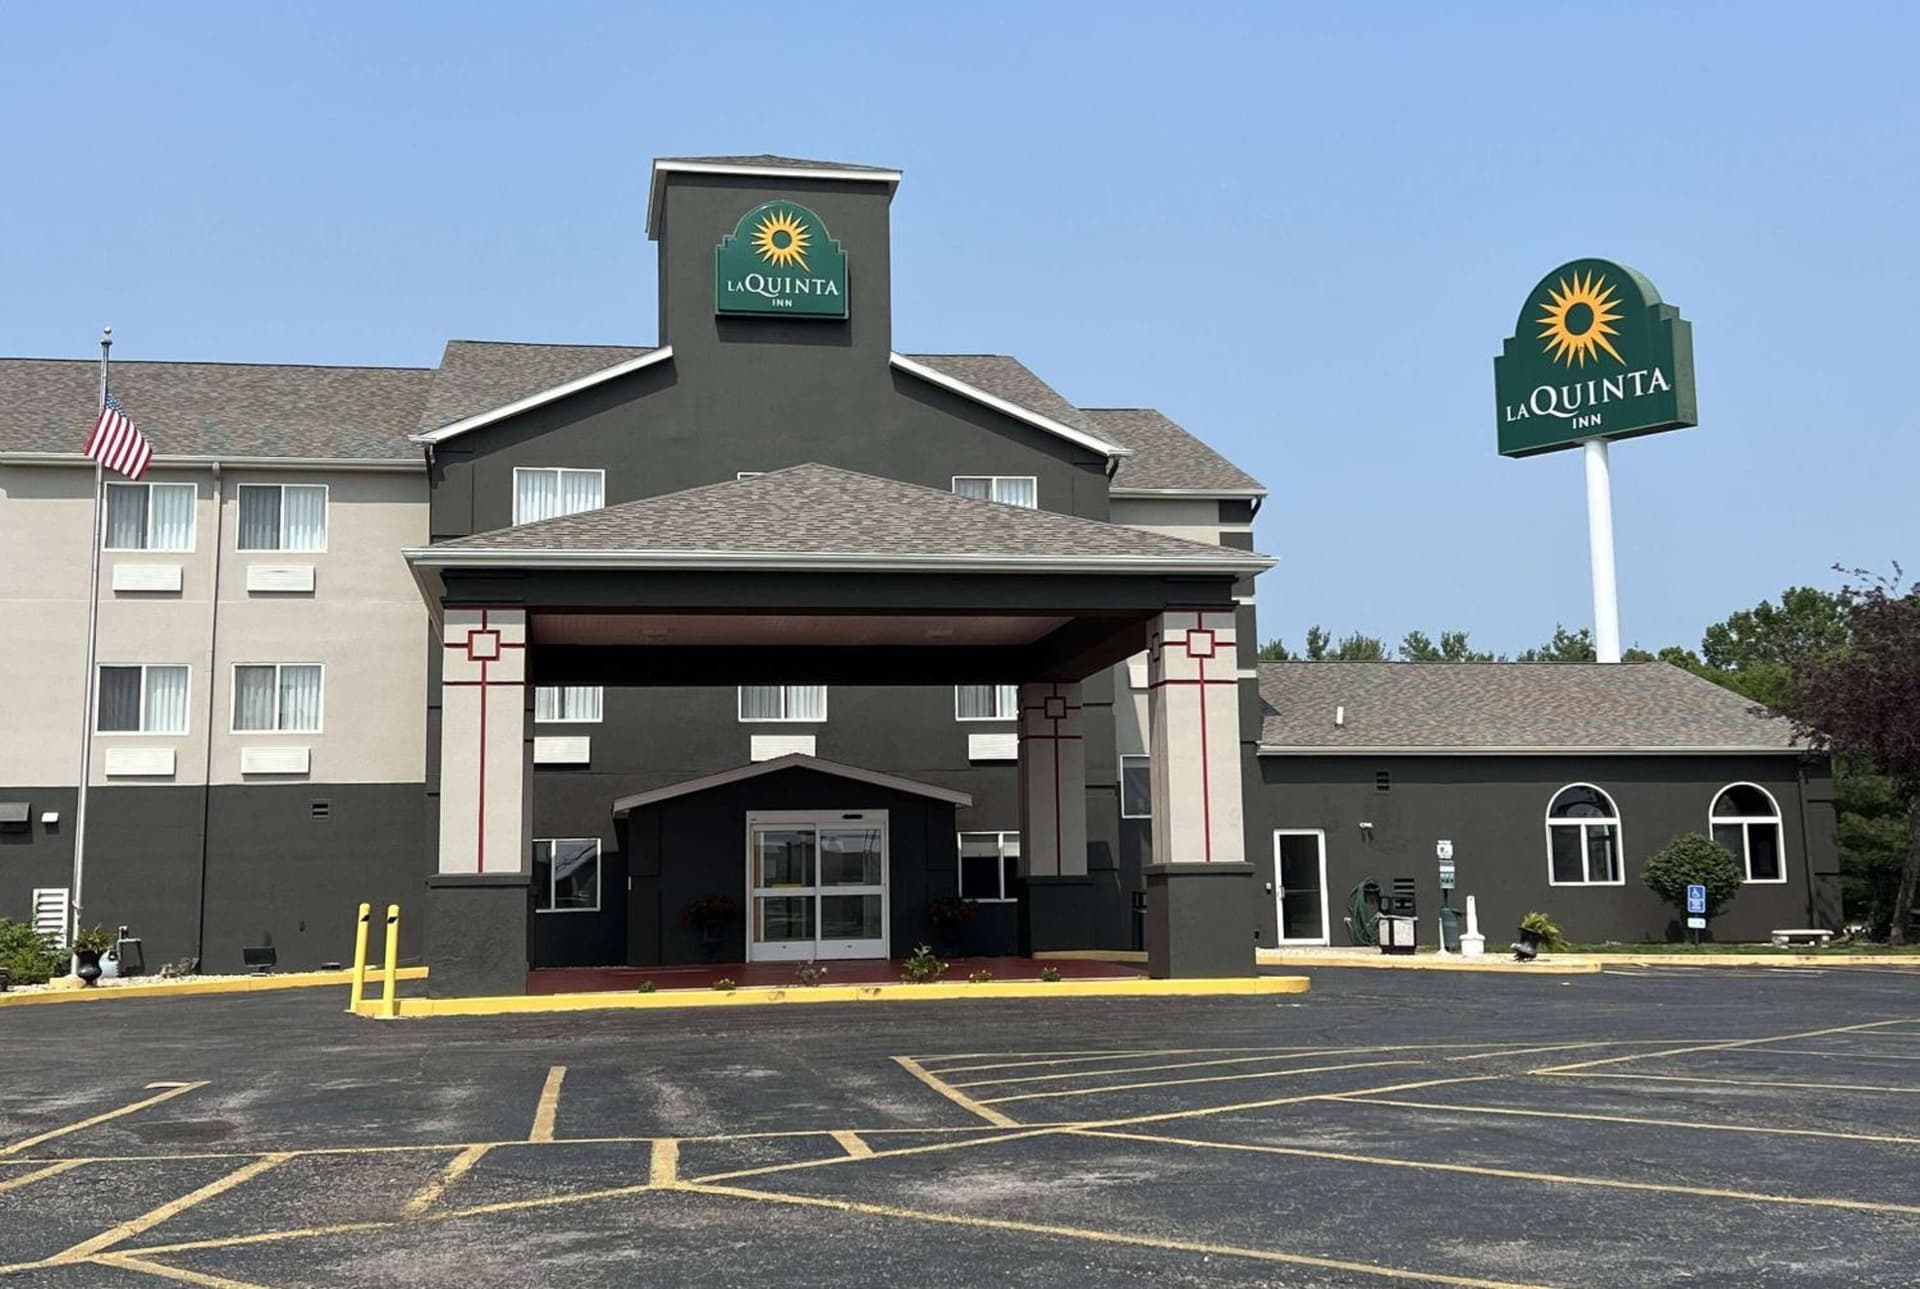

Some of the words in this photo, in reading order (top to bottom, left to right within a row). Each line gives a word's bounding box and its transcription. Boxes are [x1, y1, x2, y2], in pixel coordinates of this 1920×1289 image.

[745, 273, 839, 297] QUINTA
[772, 299, 792, 307] INN
[1530, 367, 1670, 418] QUINTA
[1572, 413, 1602, 429] INN
